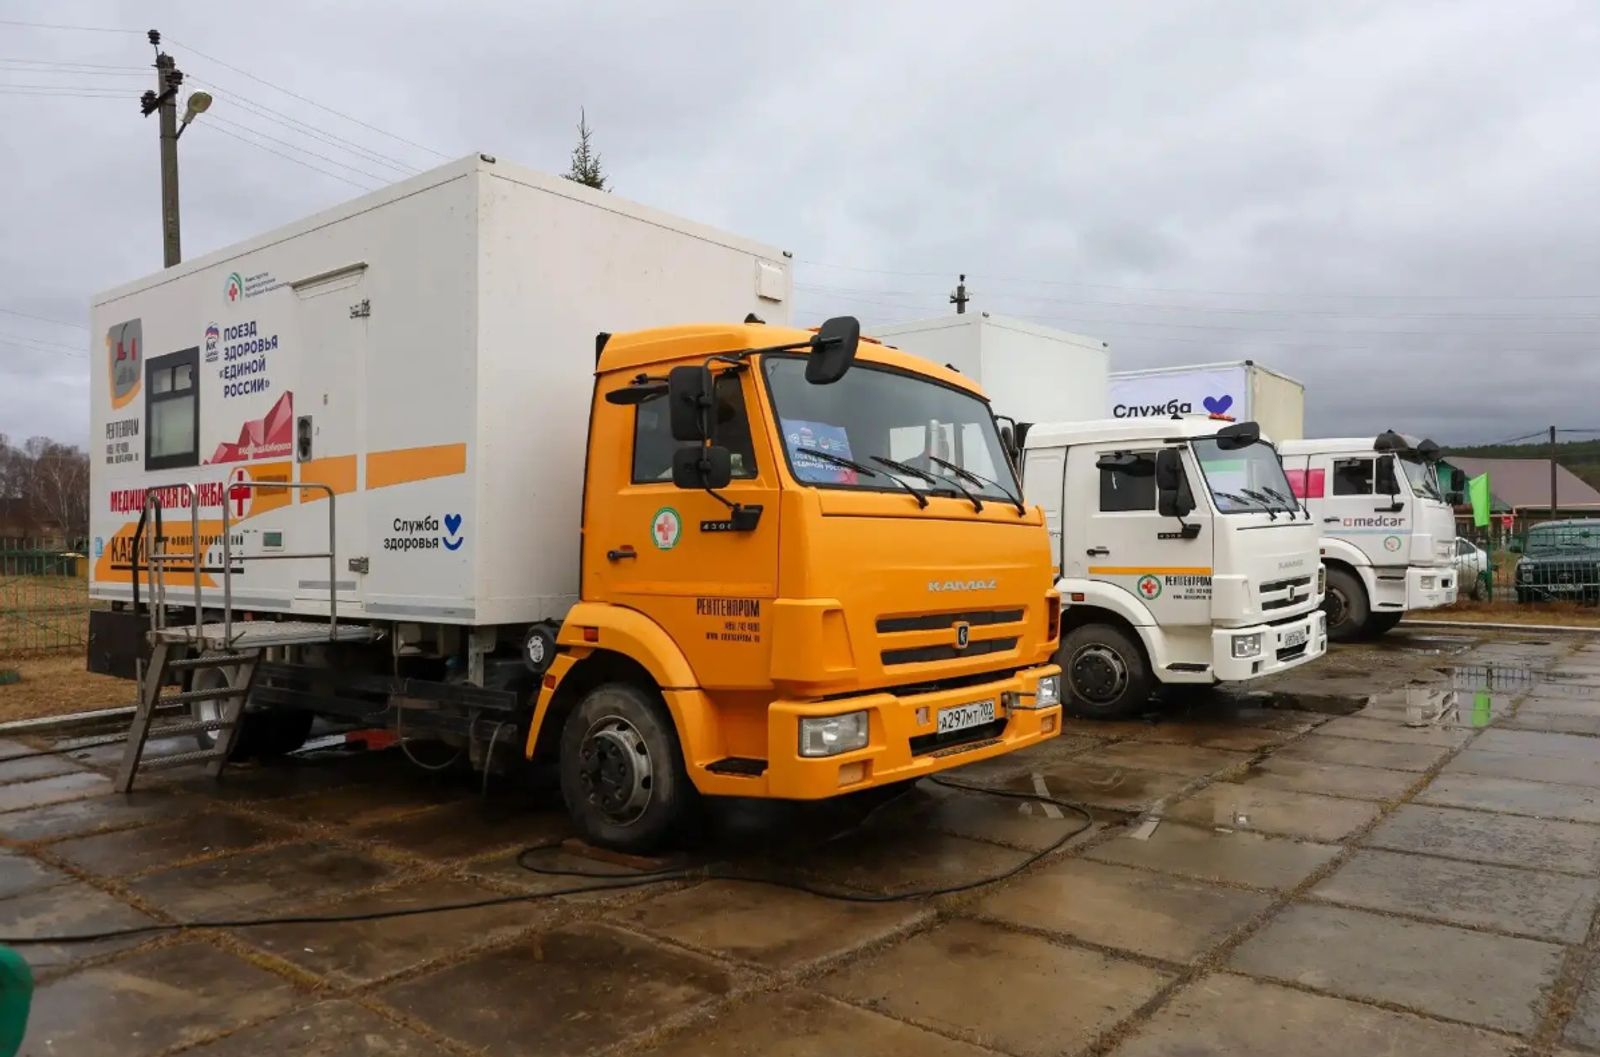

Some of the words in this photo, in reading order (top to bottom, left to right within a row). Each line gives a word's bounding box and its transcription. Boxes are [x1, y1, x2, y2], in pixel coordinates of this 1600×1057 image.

[223, 320, 257, 342] ПОЕЗД
[223, 334, 278, 362] ЗДОРОВЬЯ
[223, 377, 270, 399] РОССИИ»
[1113, 398, 1192, 418] Служба
[110, 486, 178, 514] МЕДИЦИКАЯ
[180, 482, 224, 508] СЛЖБА
[393, 515, 439, 535] Служба
[1353, 515, 1406, 527] medcar
[384, 537, 439, 552] здоровья
[928, 580, 997, 592] KAMAZ
